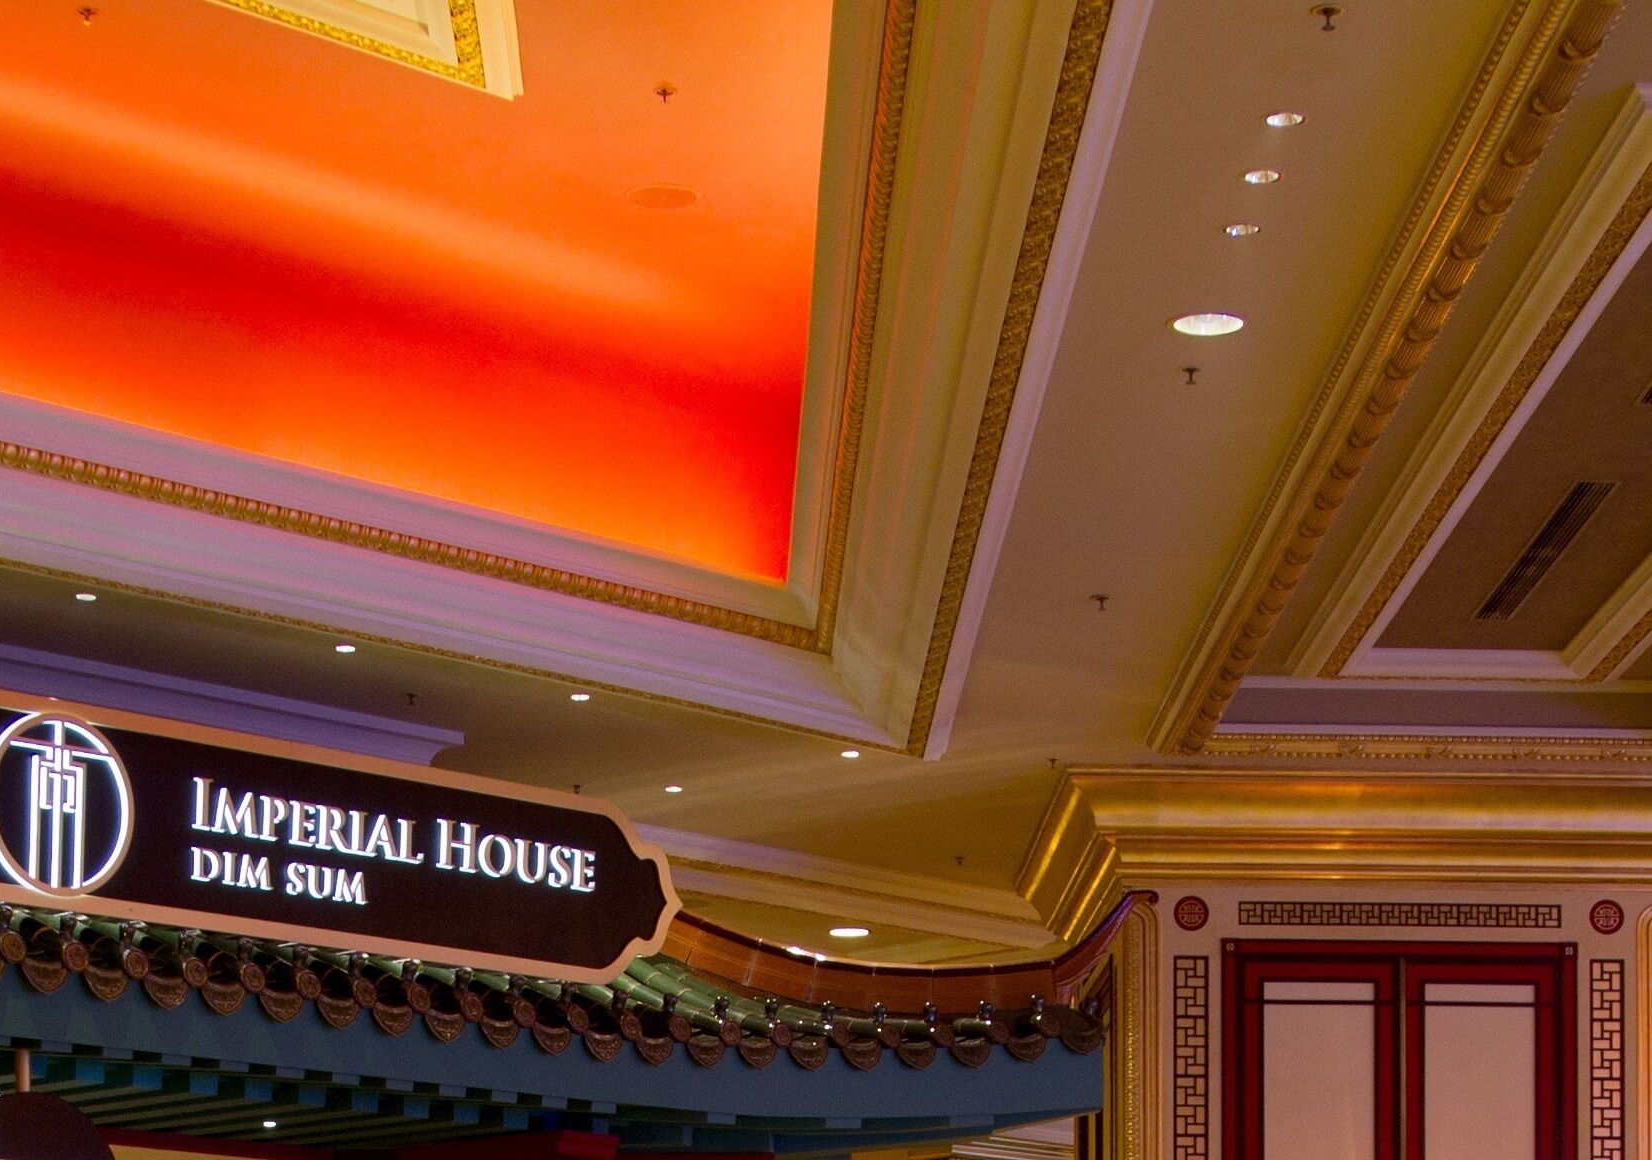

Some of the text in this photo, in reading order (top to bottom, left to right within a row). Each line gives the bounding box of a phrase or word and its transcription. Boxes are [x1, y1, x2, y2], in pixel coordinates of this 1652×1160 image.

[190, 846, 368, 906] DIM SUM
[191, 776, 597, 893] IMPERIAL HOUSE
